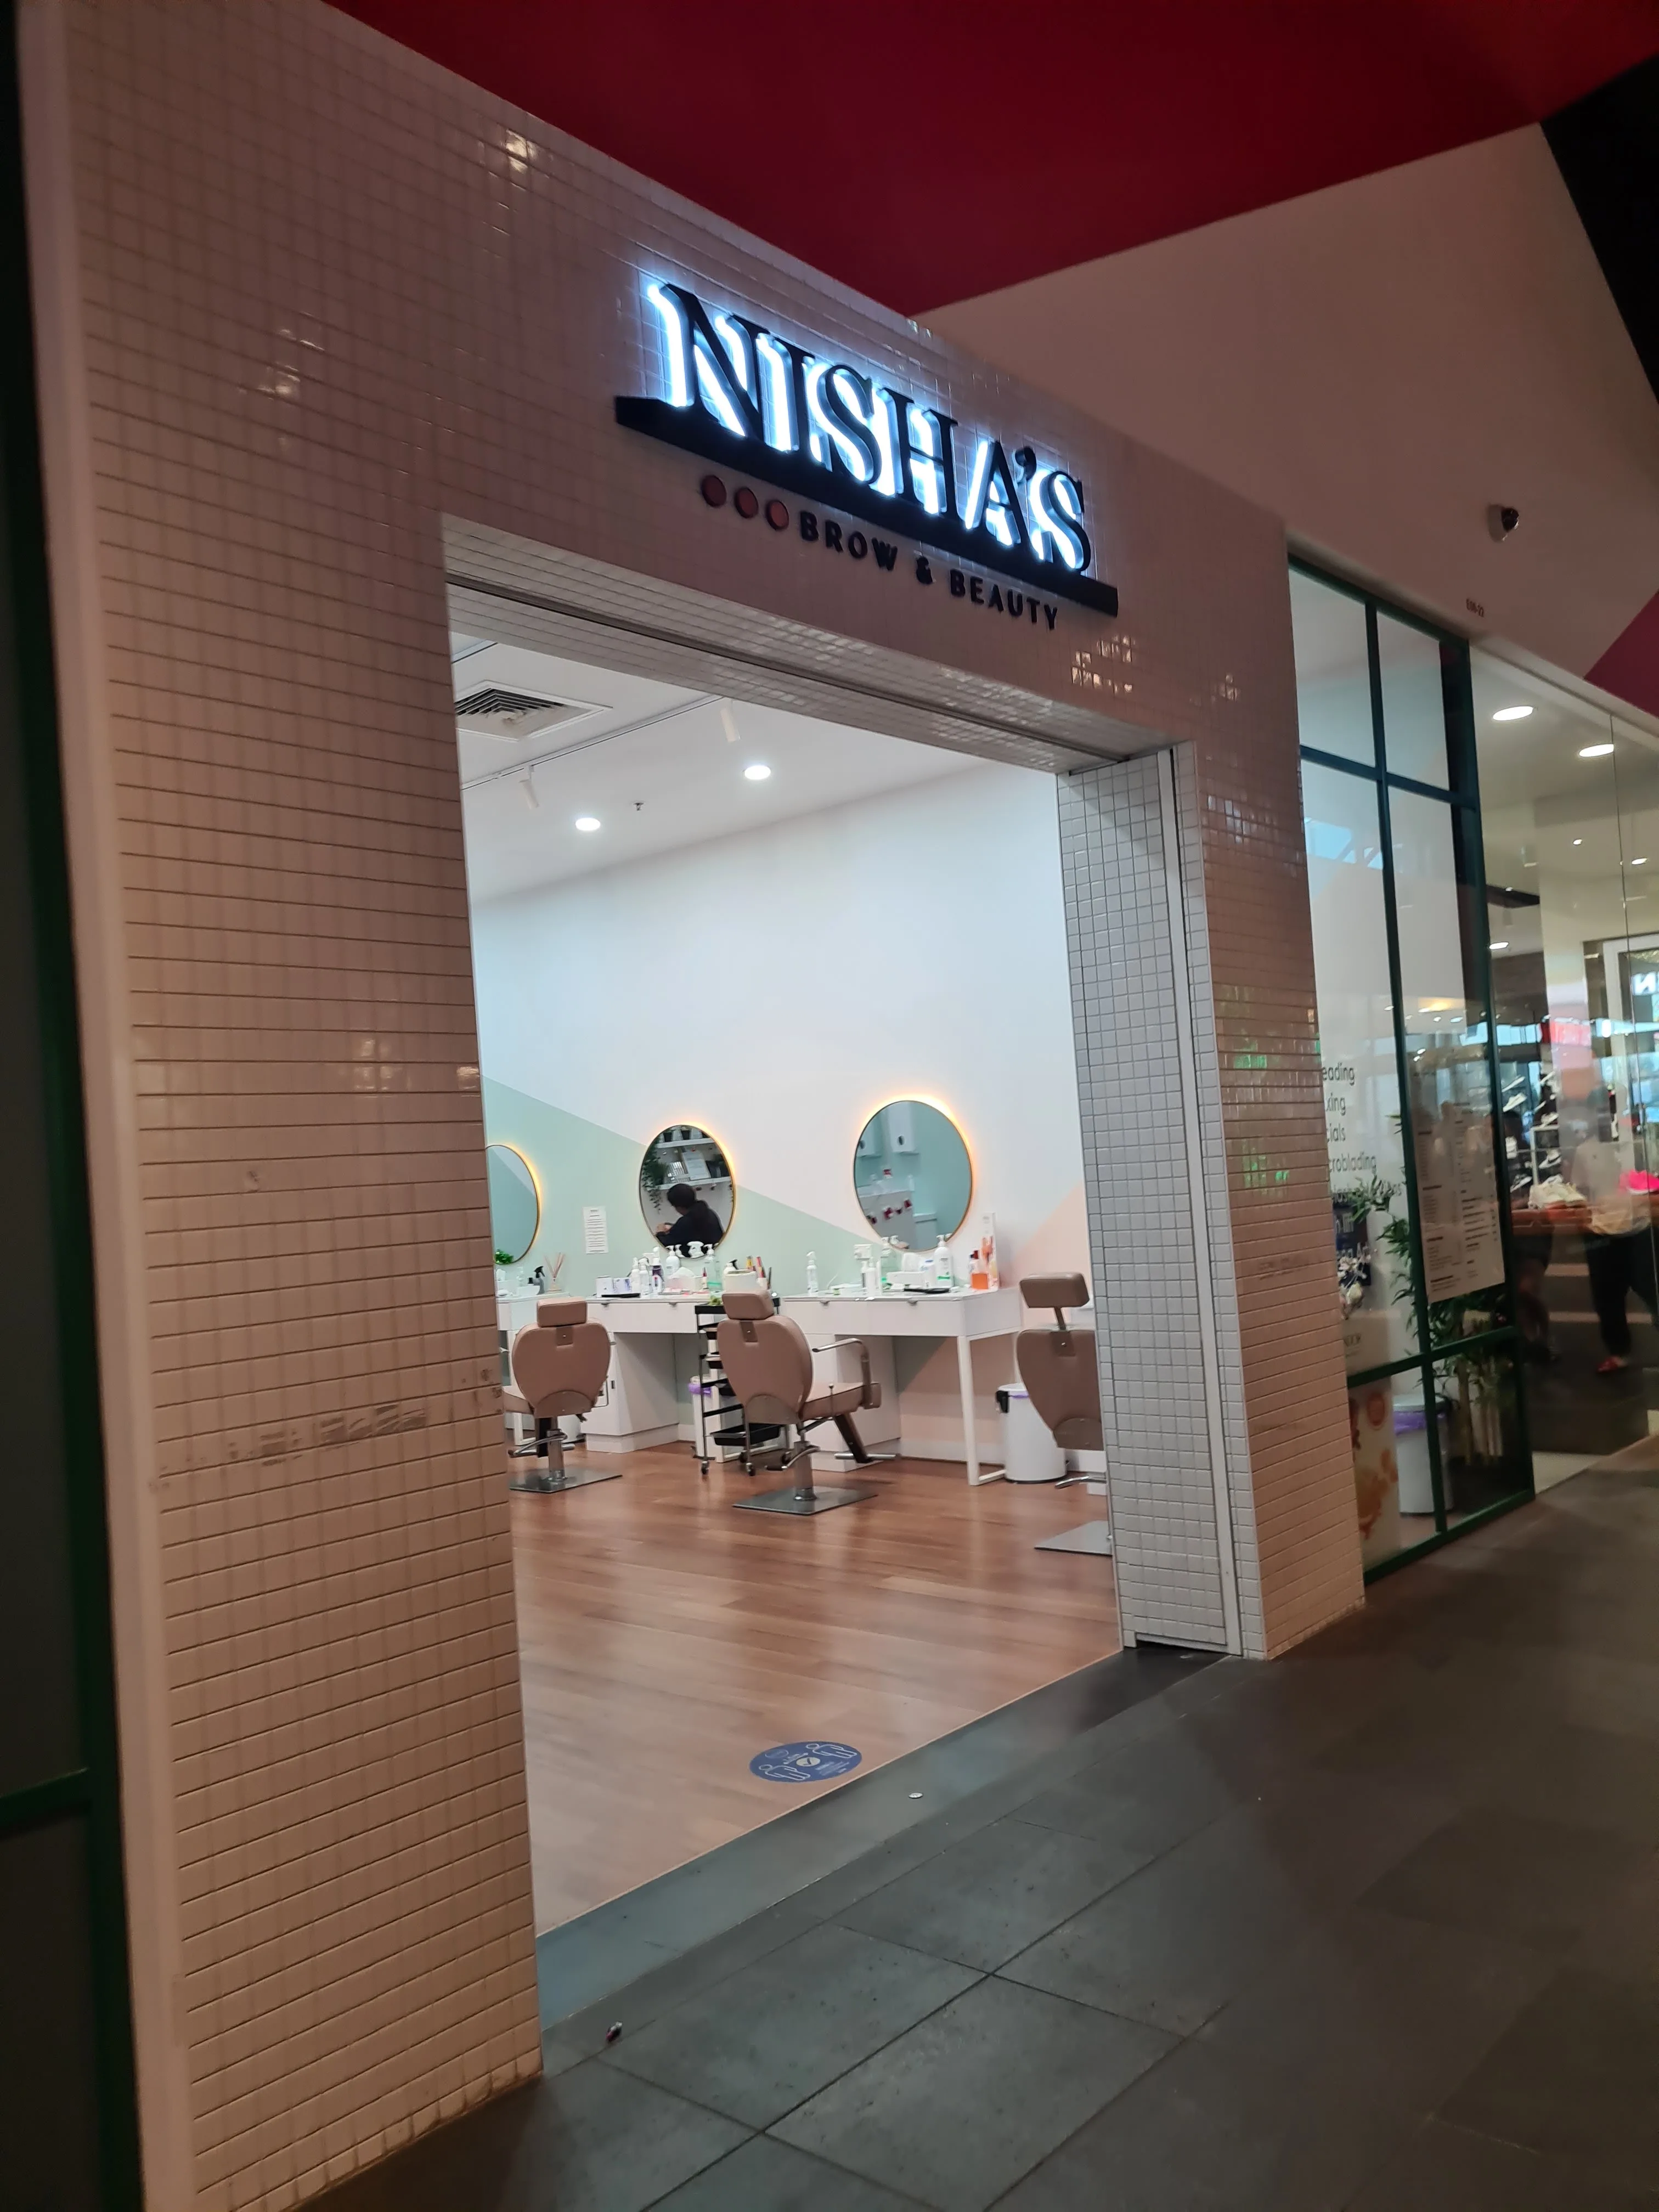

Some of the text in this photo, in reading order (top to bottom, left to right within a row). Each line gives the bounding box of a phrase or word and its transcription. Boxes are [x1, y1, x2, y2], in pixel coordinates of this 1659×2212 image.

[655, 283, 1092, 574] NISHA'S
[800, 511, 1058, 630] BROW & BEAUTY
